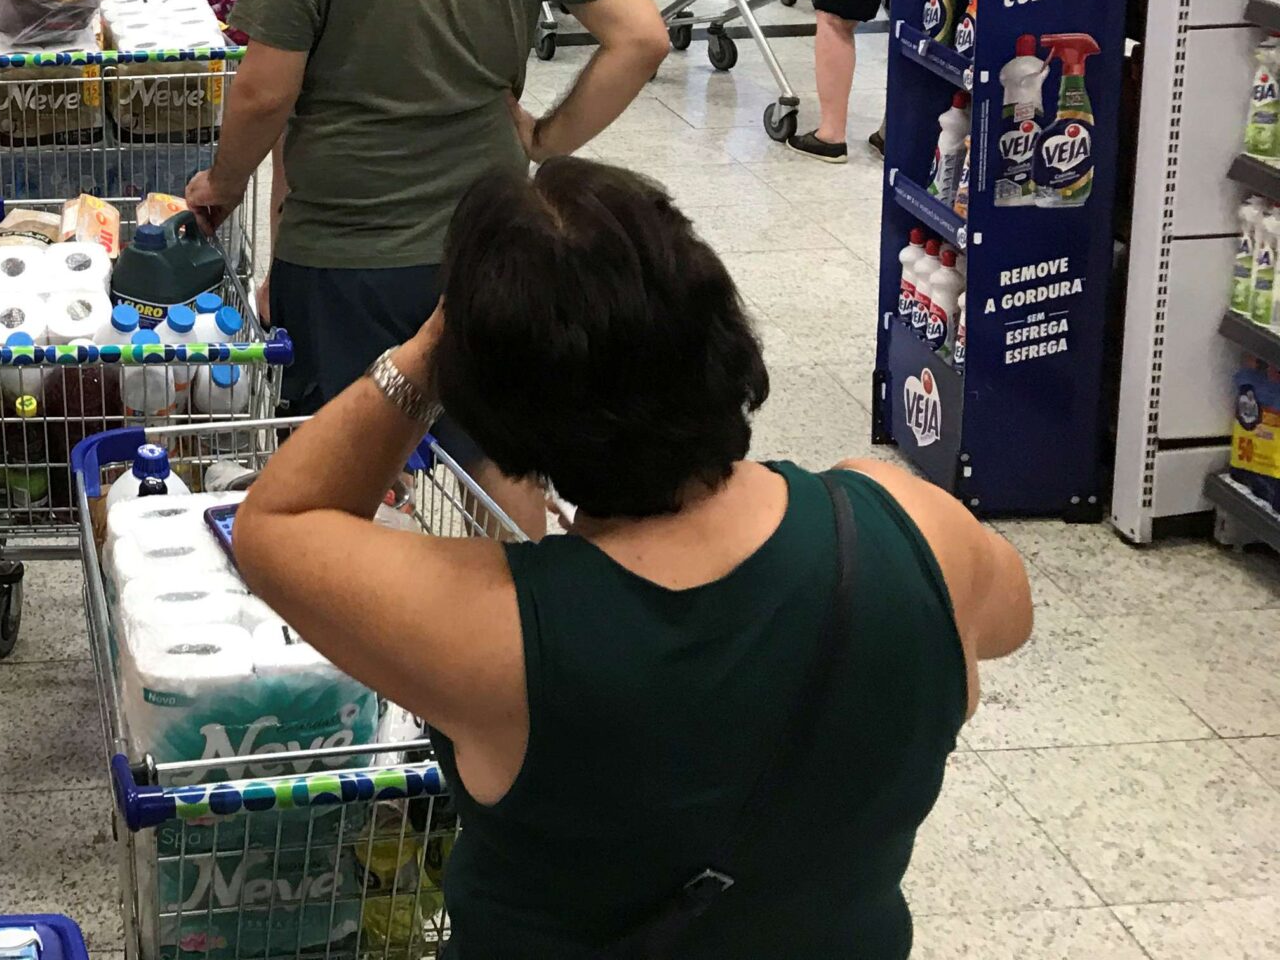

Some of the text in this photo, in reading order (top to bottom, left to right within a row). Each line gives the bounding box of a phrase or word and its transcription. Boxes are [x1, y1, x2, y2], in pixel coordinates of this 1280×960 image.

[119, 77, 205, 107] Neve
[1045, 136, 1087, 165] VEJA
[1000, 257, 1069, 286] REMOVE
[985, 278, 1083, 314] A GORDURA
[1006, 319, 1069, 345] ESFREGA
[1027, 312, 1045, 323] SEM
[1005, 338, 1068, 365] ESFREGA
[905, 390, 940, 440] VEJA
[168, 716, 354, 785] Neve
[161, 827, 202, 847] Spa
[167, 846, 344, 912] Neve
